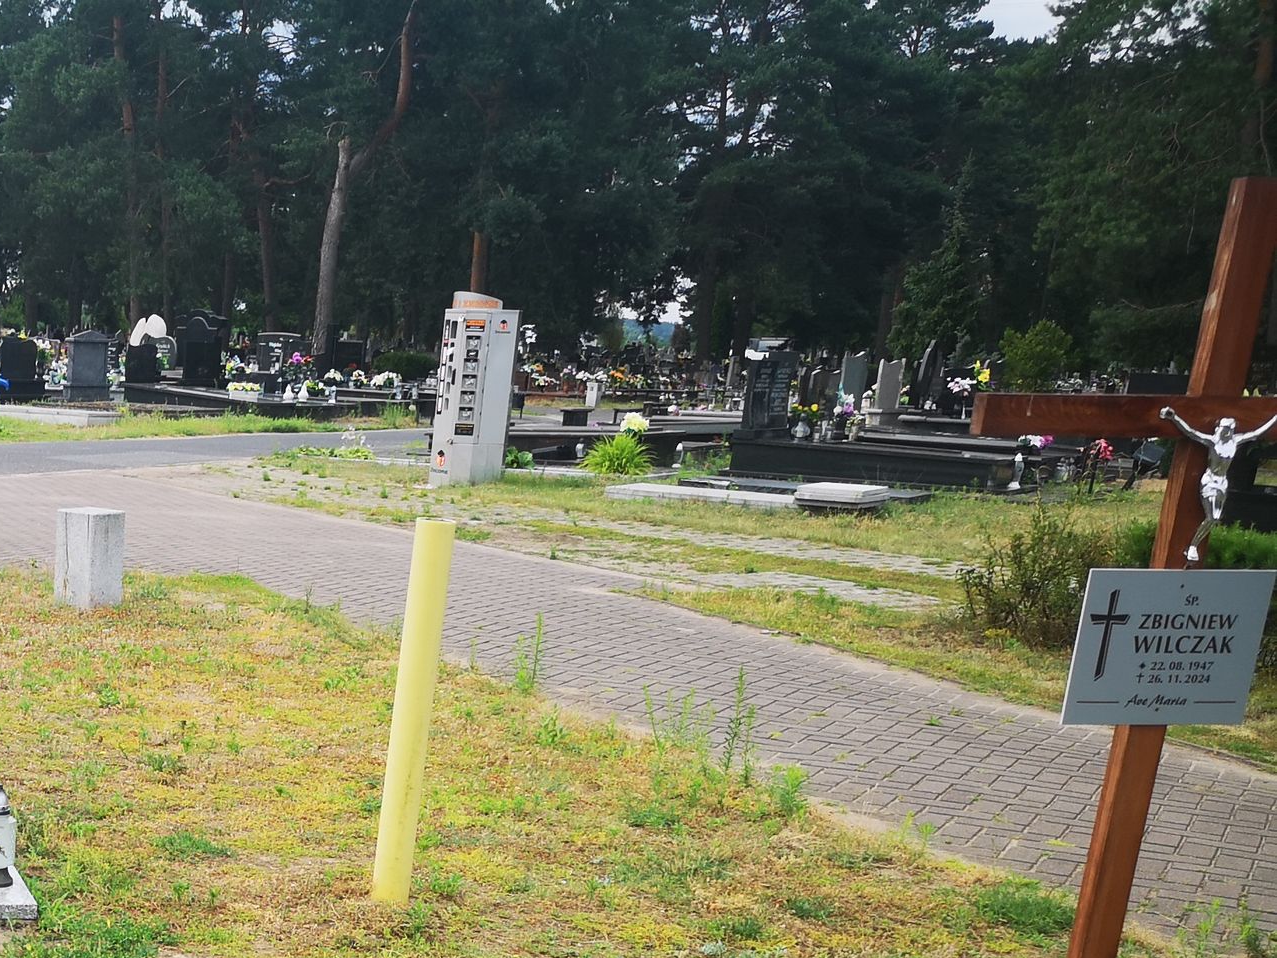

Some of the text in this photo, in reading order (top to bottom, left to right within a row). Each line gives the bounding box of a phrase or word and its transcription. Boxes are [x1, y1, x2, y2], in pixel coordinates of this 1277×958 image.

[1138, 613, 1239, 630] ZBIGNIEW
[1134, 635, 1236, 654] WILCZAK
[1124, 694, 1188, 708] Ave Maria
